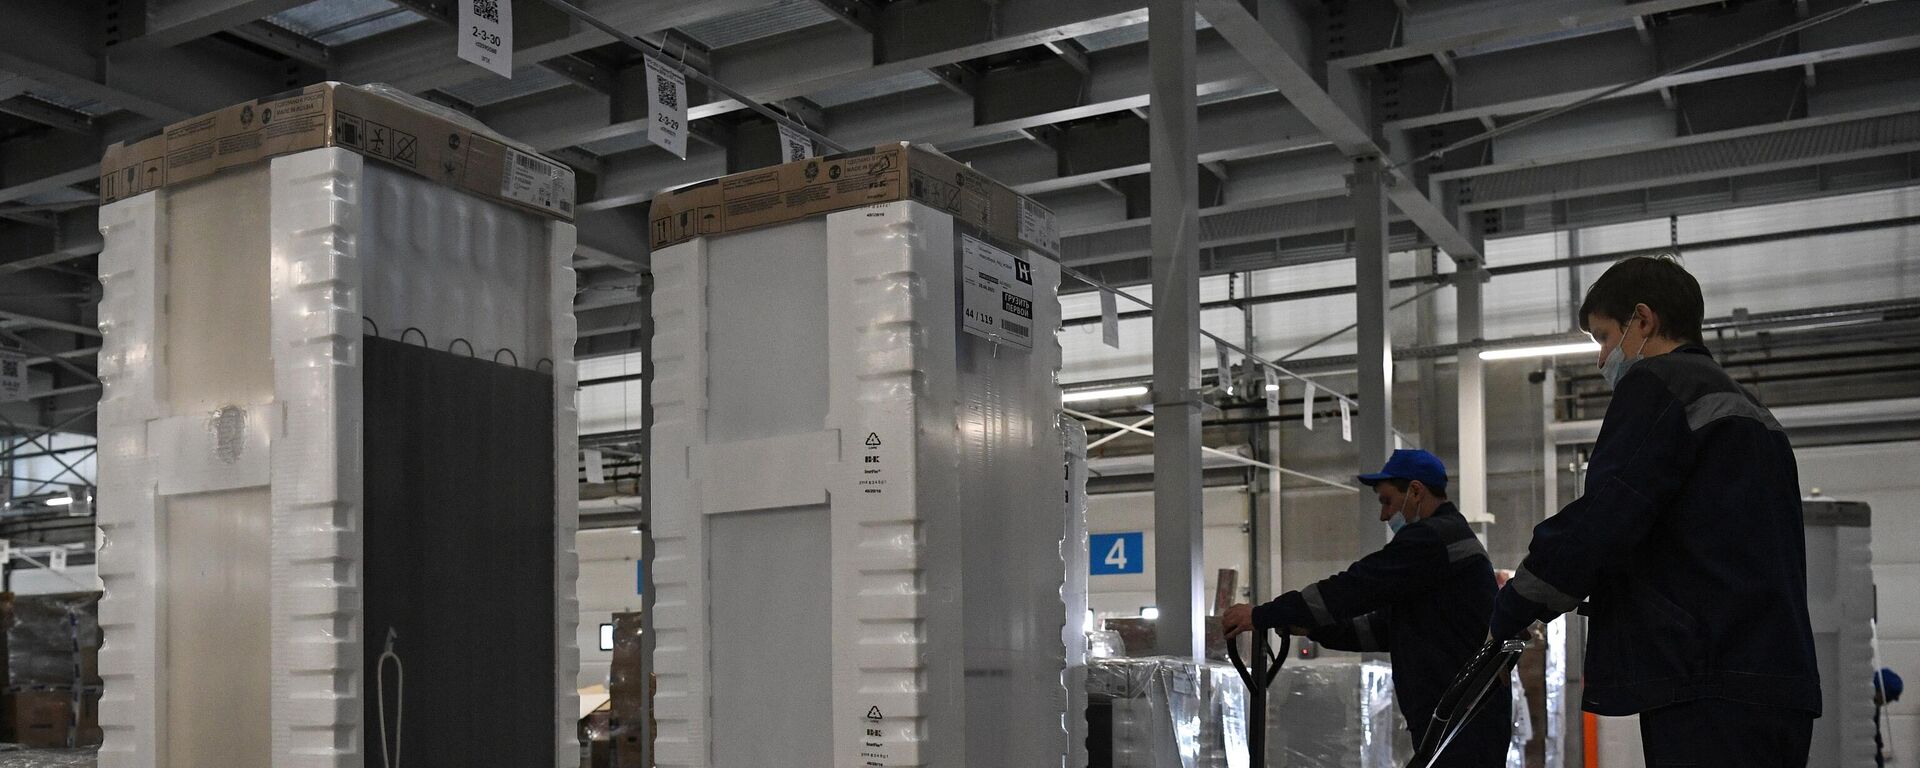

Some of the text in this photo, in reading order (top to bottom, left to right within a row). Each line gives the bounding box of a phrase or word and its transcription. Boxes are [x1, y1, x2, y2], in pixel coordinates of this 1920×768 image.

[472, 26, 501, 47] 2-3-30
[658, 112, 680, 131] 2-3-29
[1004, 293, 1030, 309] ГРУЗИТЬ
[966, 307, 974, 319] 44
[980, 313, 993, 325] 119
[1104, 538, 1127, 569] 4
